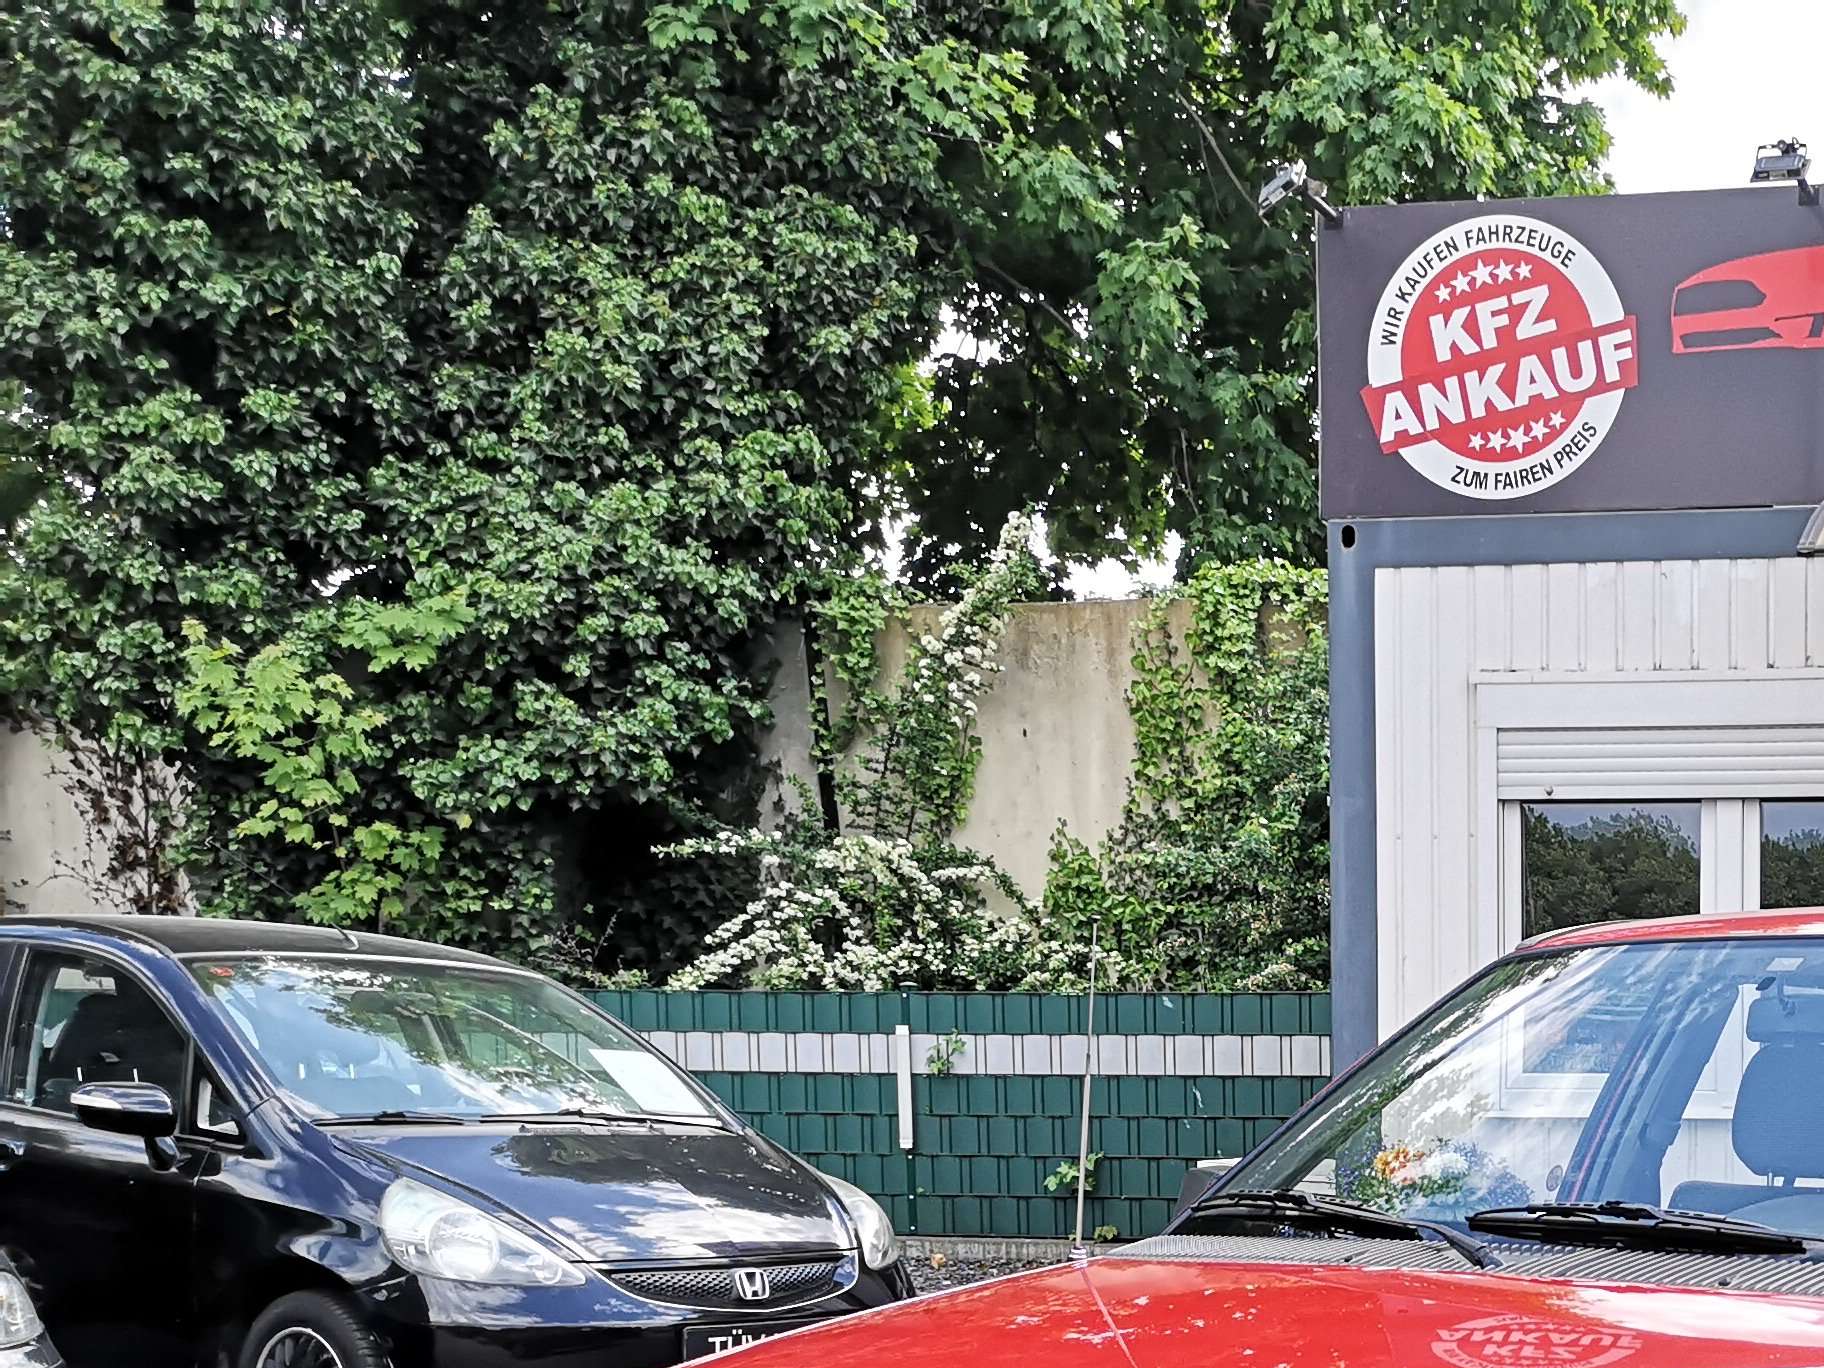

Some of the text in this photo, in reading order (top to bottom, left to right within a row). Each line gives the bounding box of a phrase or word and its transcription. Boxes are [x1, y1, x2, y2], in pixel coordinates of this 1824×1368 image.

[1381, 224, 1576, 346] WIR KAUFEN FAHRZEUGE
[1429, 284, 1557, 363] KFZ
[1380, 329, 1633, 444] ANKAUF
[1451, 421, 1597, 491] ZUM FAIREN PREIS
